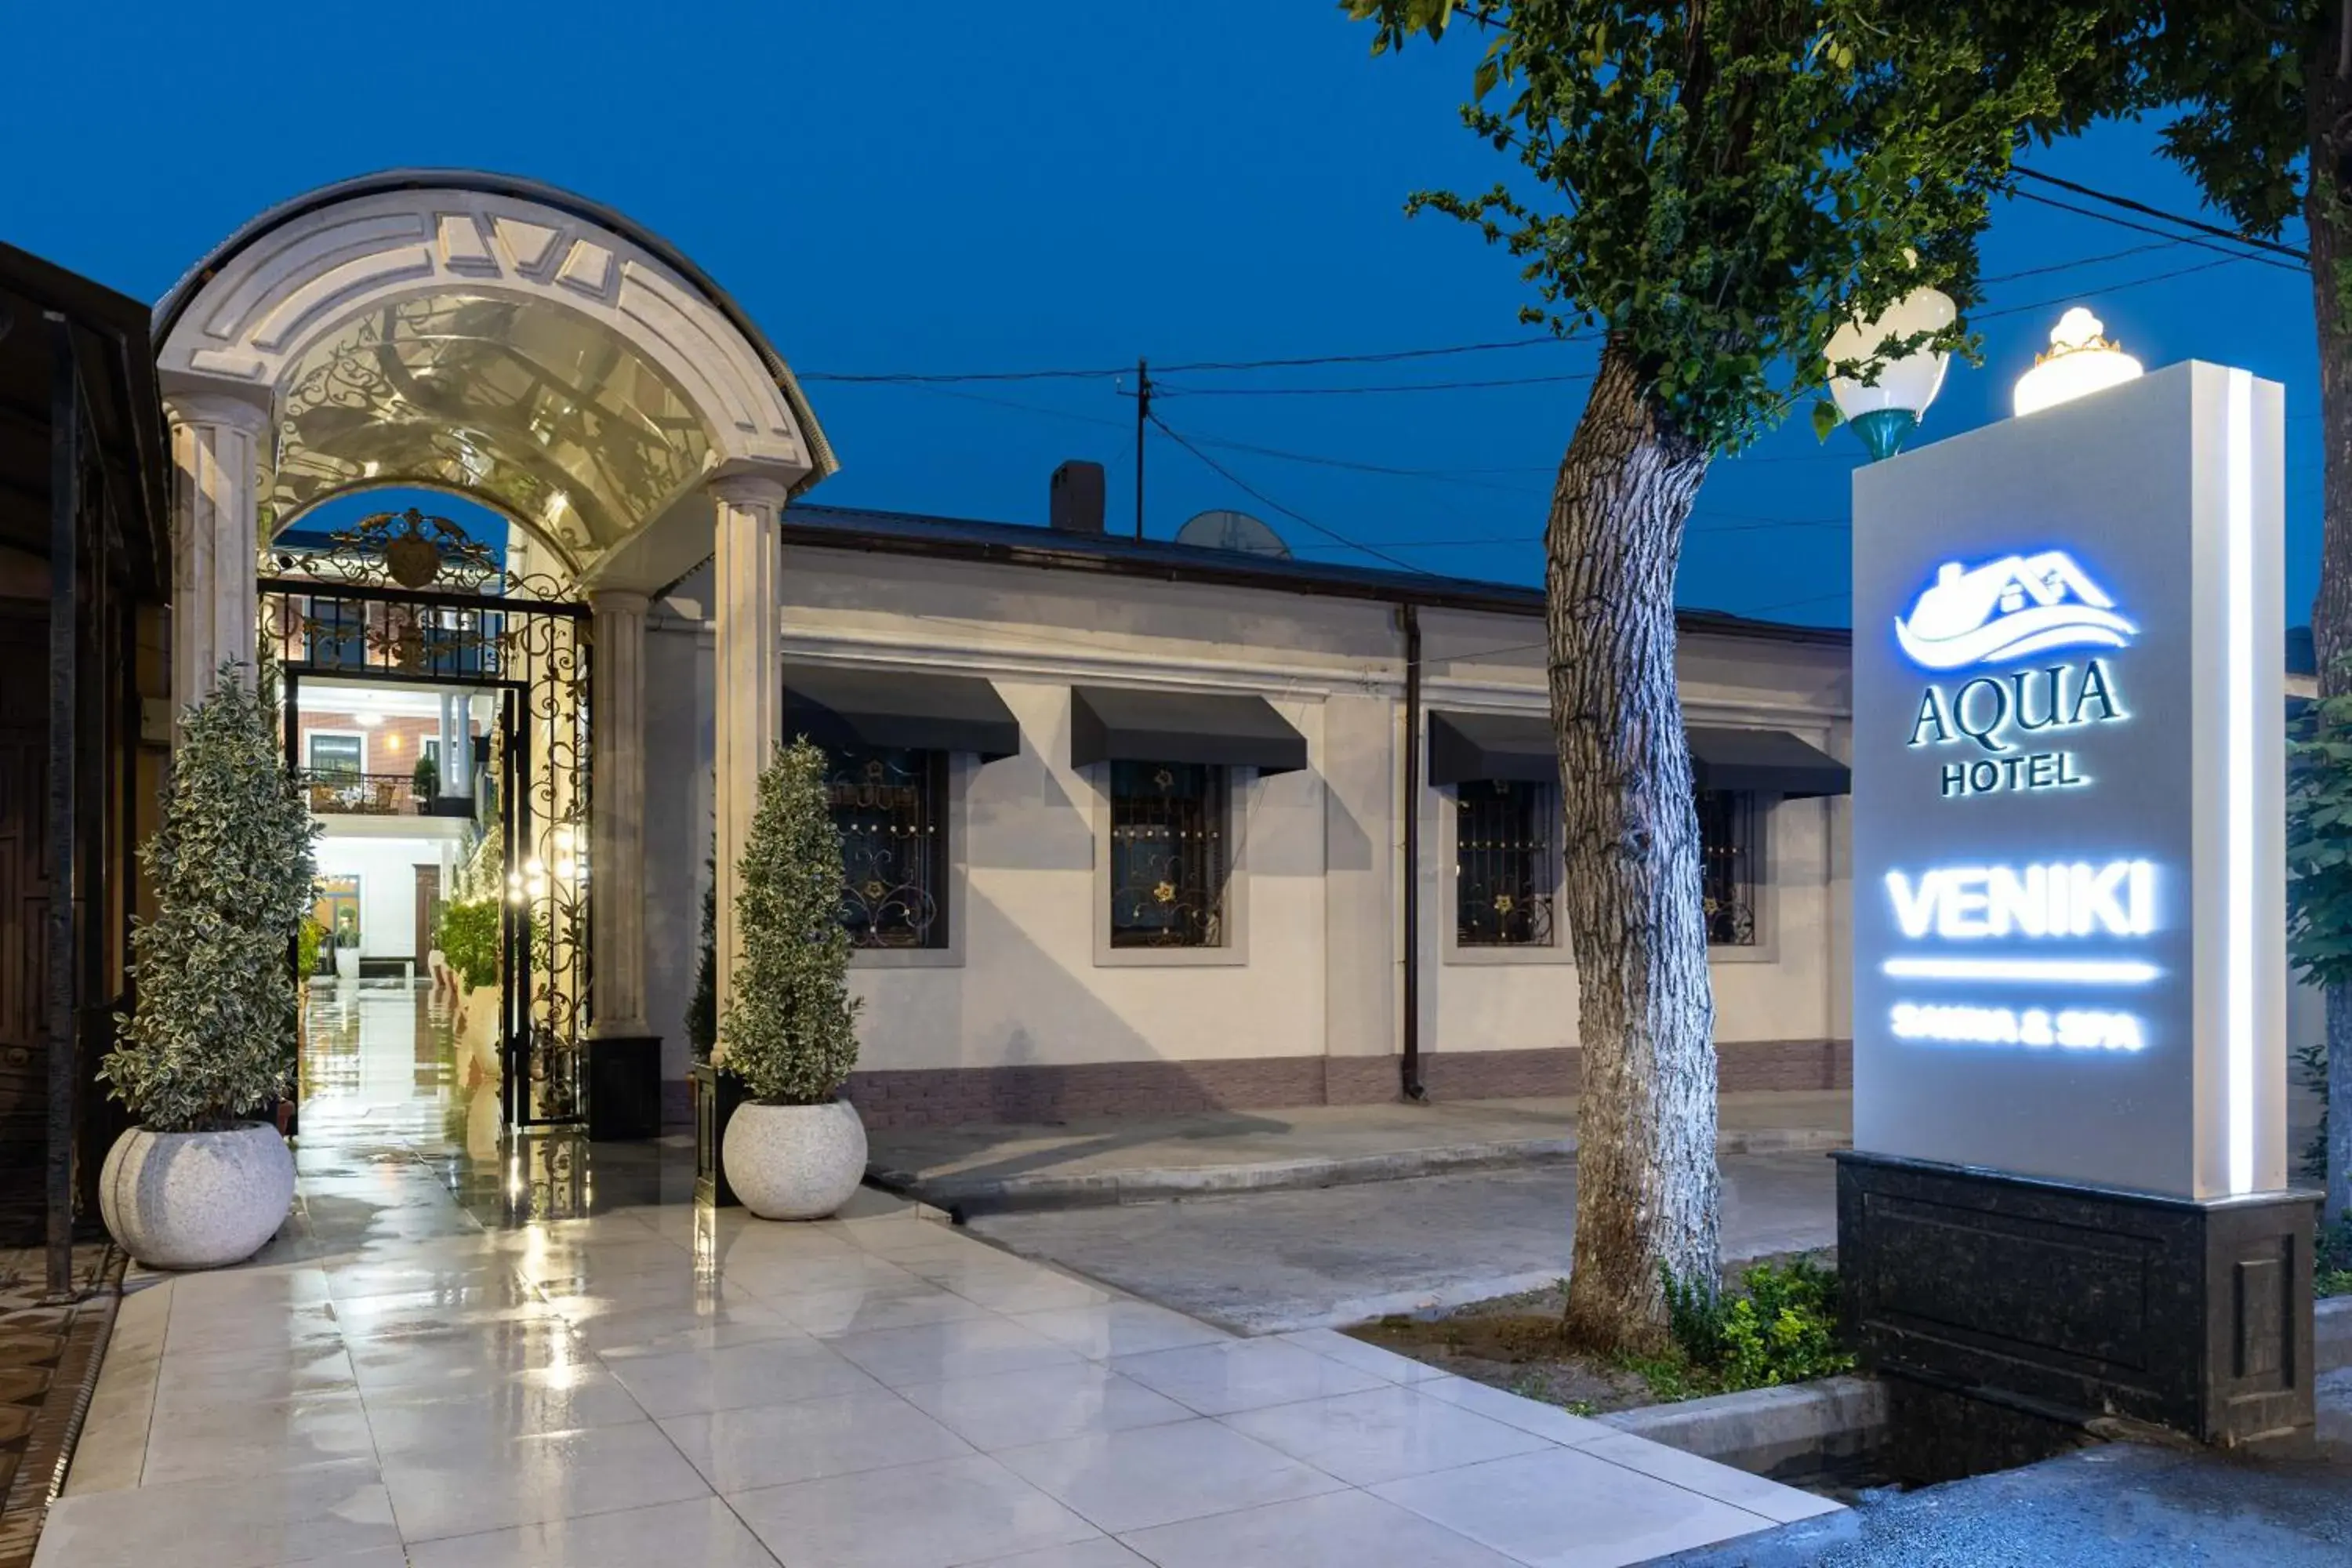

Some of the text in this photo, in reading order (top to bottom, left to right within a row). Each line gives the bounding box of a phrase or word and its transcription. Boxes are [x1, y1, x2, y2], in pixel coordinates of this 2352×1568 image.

[1907, 658, 2122, 751] AQUA
[1942, 753, 2081, 796] HOTEL
[1887, 860, 2154, 937] VENIKI
